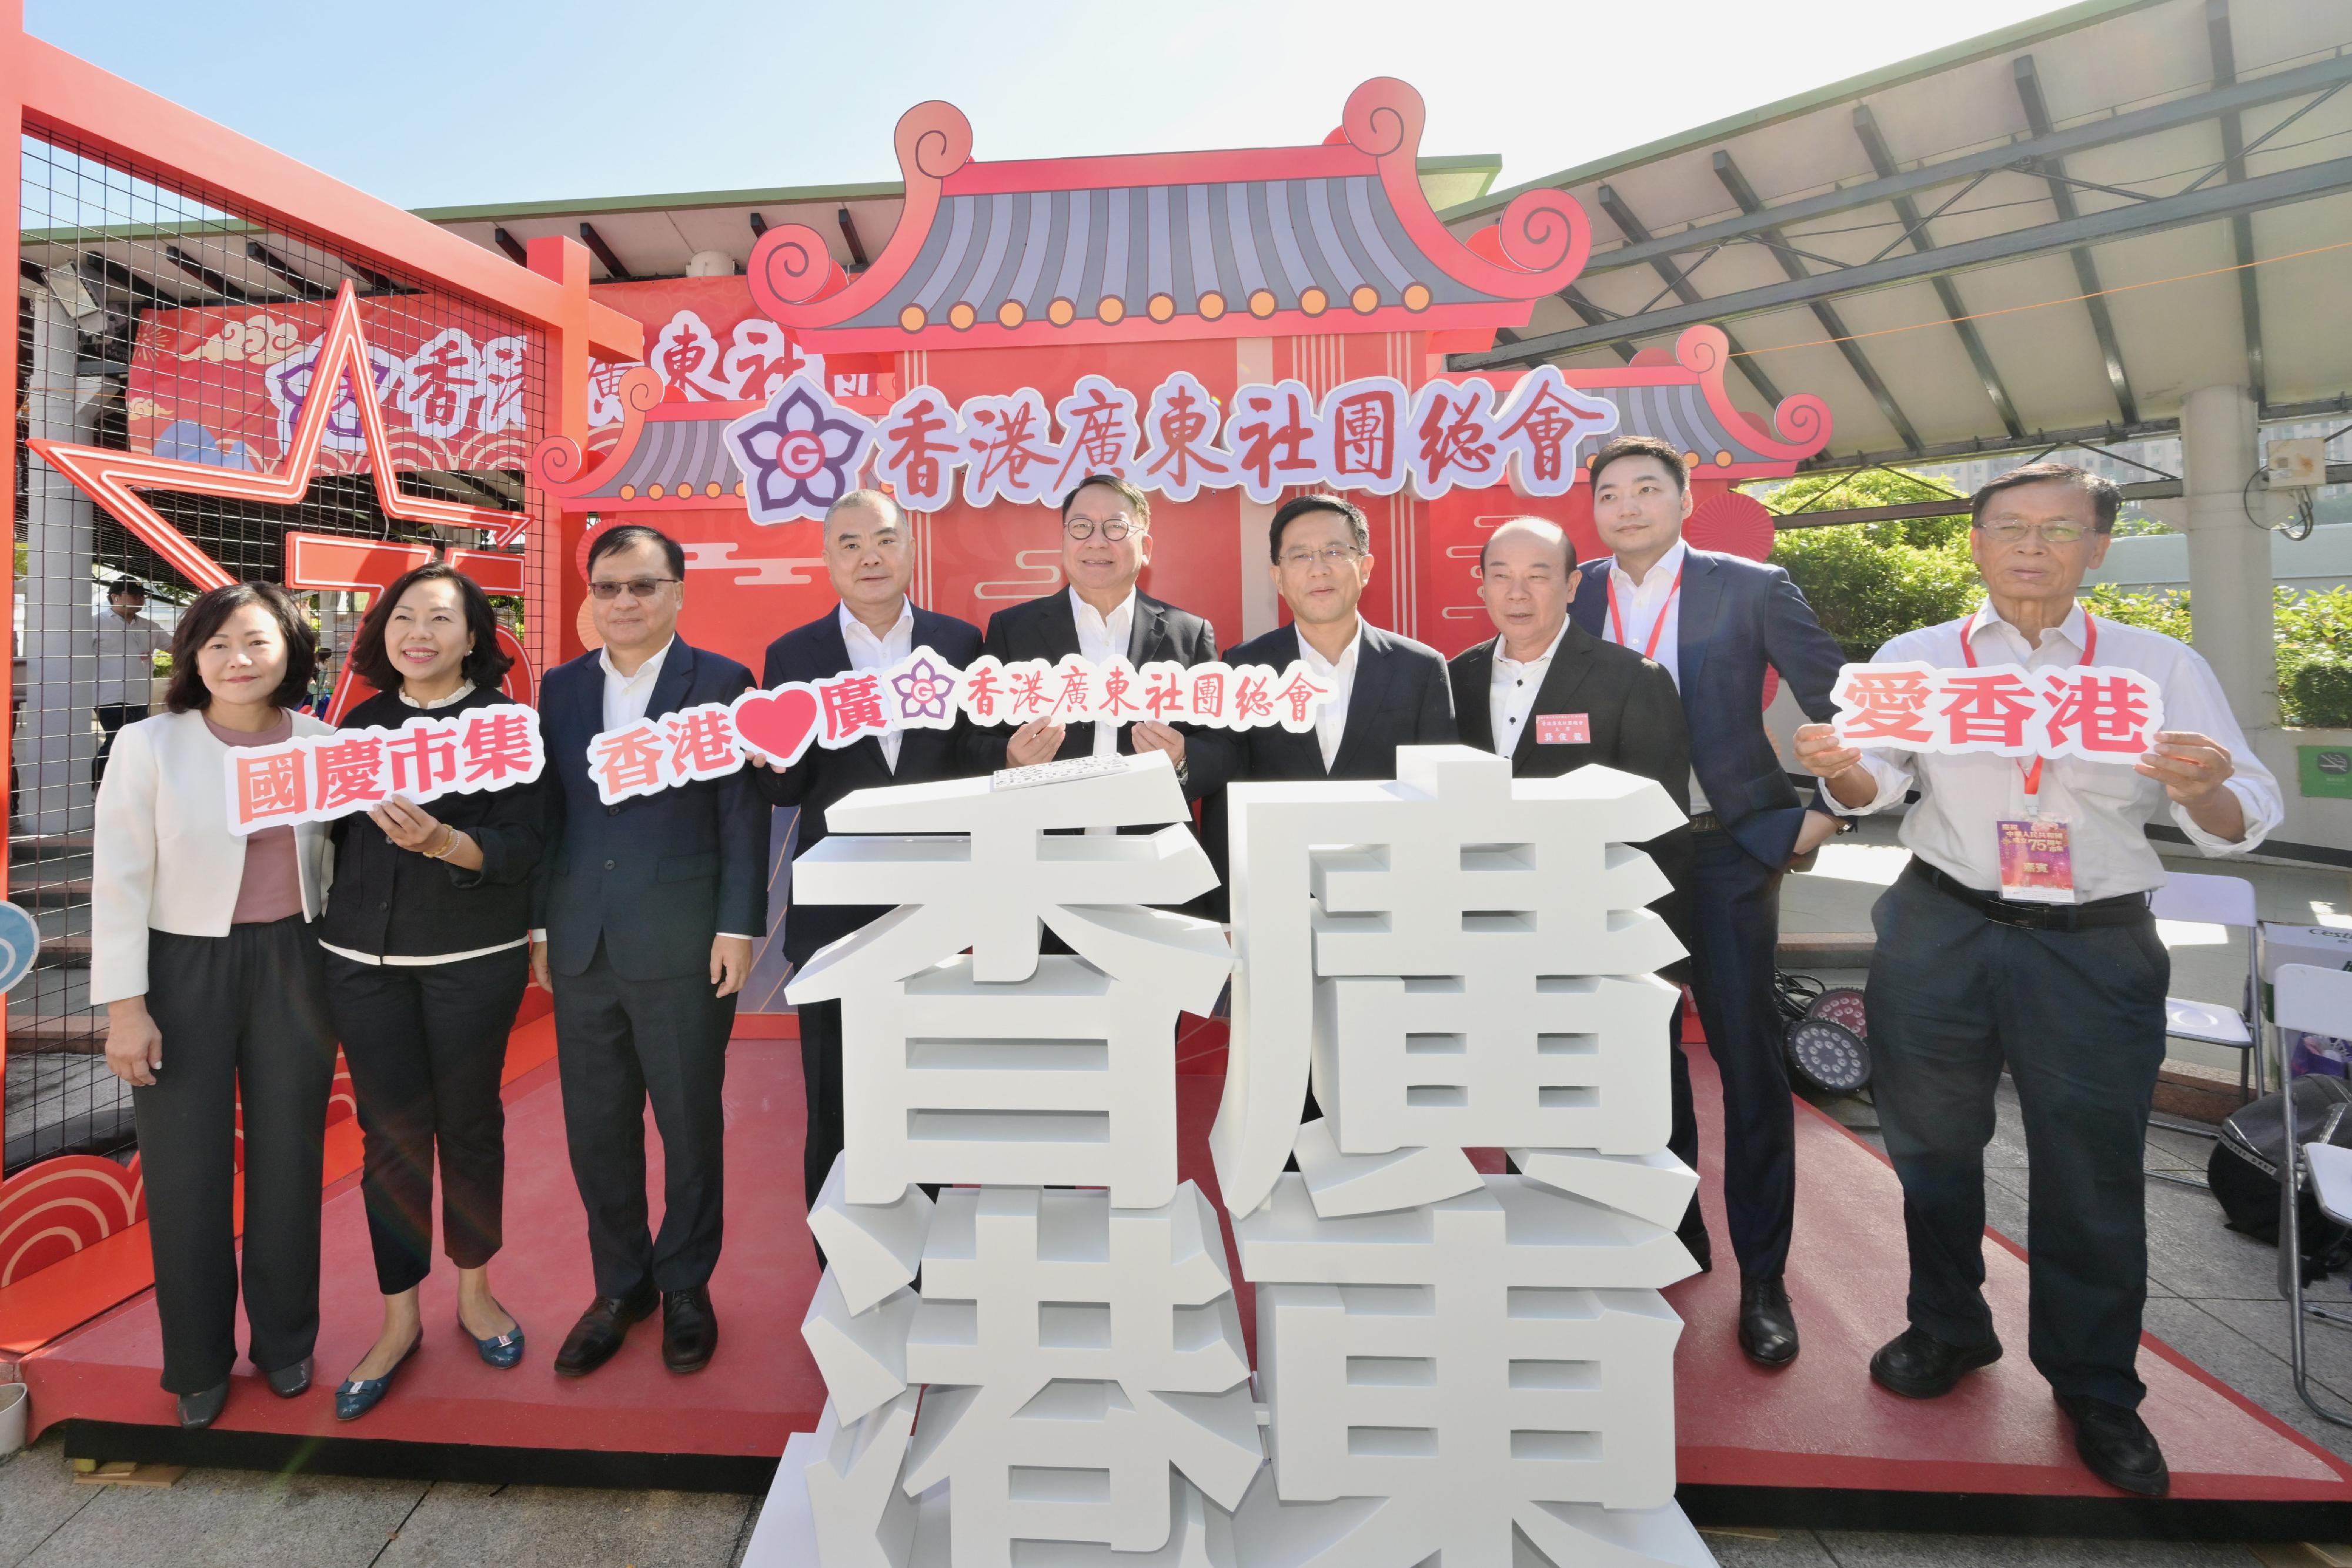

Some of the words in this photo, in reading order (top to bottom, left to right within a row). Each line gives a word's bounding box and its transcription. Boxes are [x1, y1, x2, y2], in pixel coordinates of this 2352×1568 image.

[782, 437, 820, 473] G
[238, 714, 532, 824] 國慶市集
[596, 711, 736, 795] 香港
[819, 674, 894, 740] 廣
[1843, 670, 2149, 753] 愛香港
[784, 748, 1264, 1568] 香港
[1208, 744, 1703, 1568] 廣東
